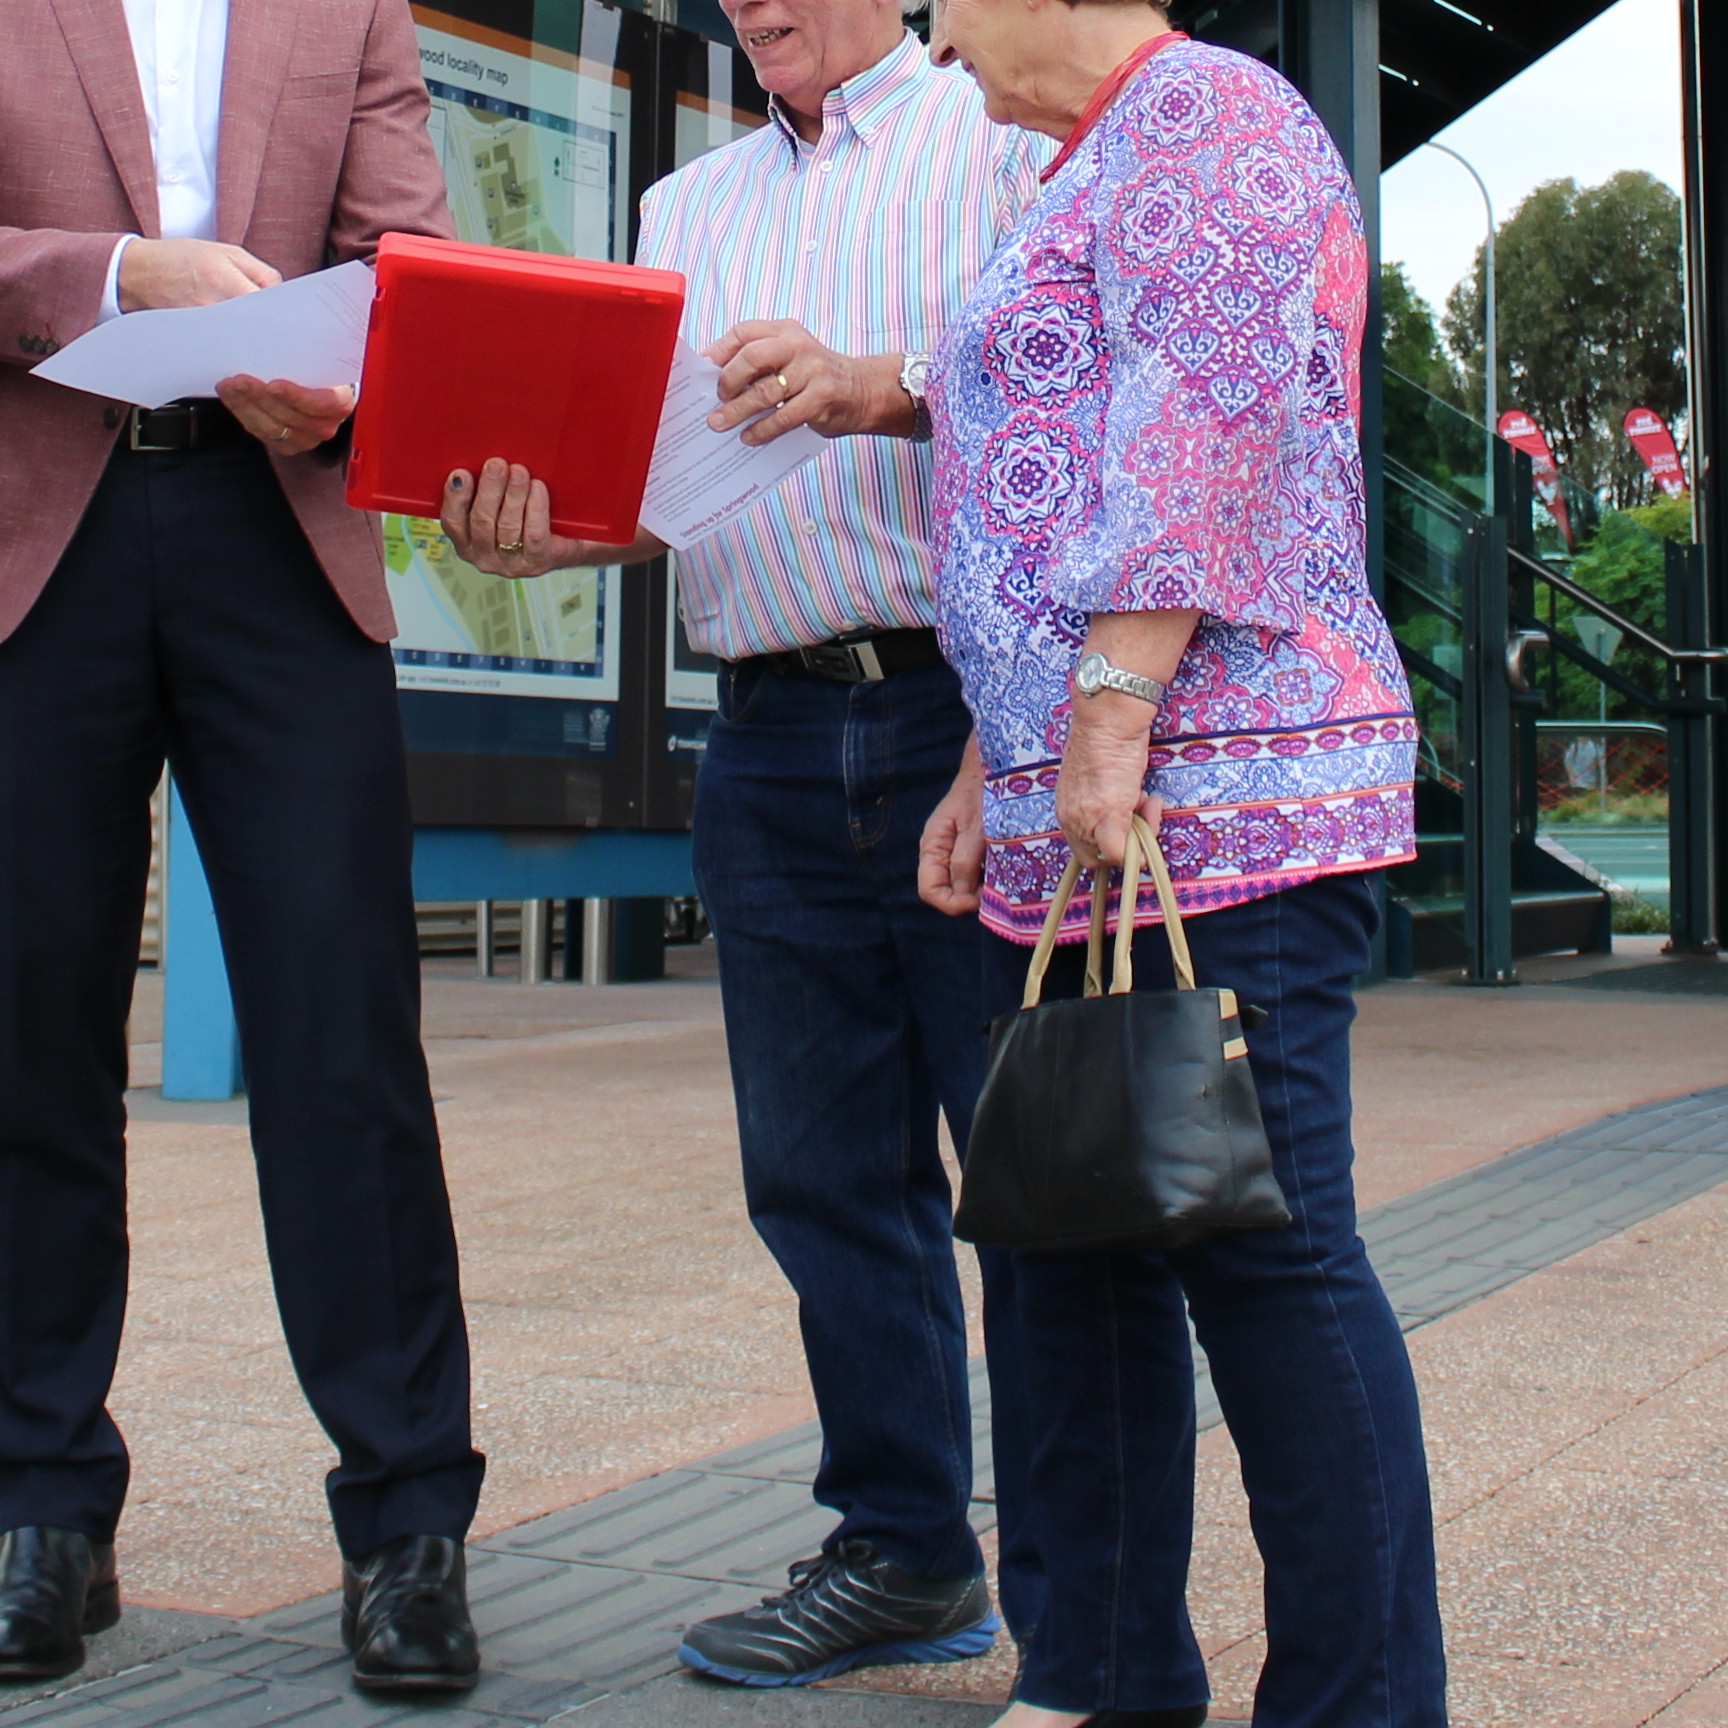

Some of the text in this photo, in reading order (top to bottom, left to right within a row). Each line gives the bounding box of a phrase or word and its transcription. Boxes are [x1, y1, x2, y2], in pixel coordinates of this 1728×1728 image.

[447, 53, 485, 81] locality
[486, 67, 509, 88] map
[1652, 463, 1677, 474] OPEN
